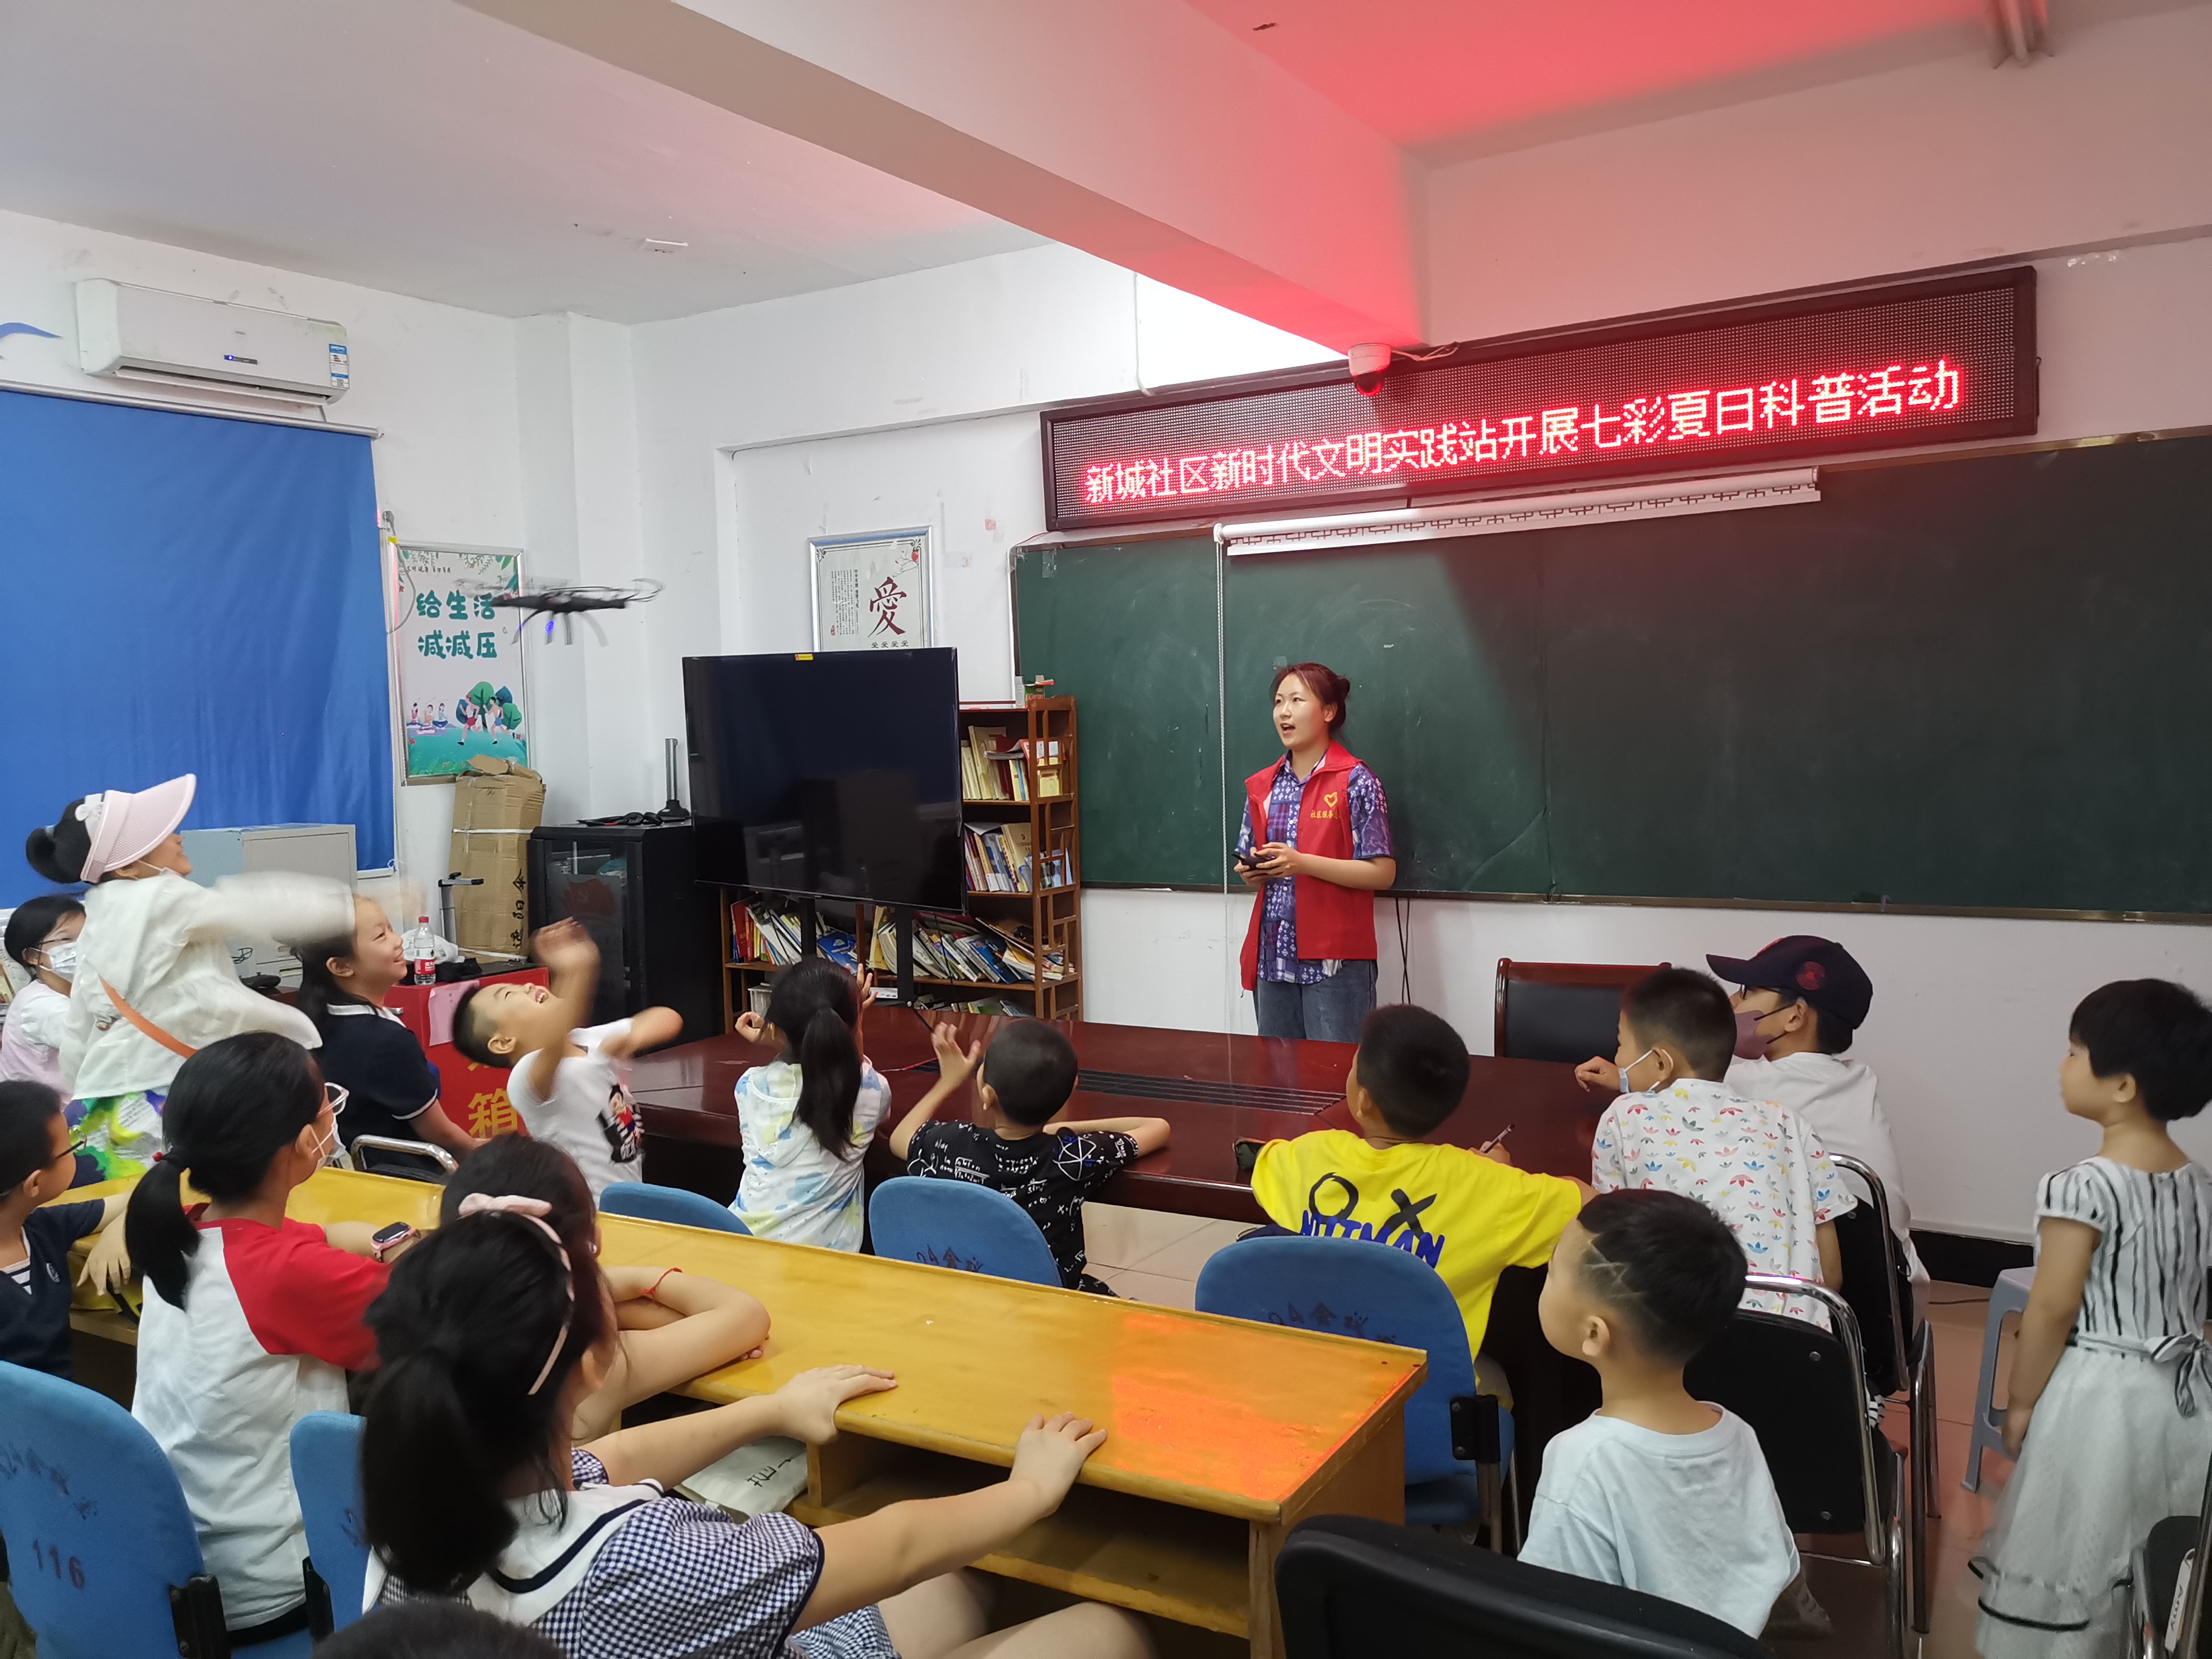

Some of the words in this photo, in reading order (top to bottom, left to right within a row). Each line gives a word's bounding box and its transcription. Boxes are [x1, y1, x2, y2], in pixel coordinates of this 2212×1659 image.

[1083, 357, 1962, 504] 新城社区新时代文明实践站开展七彩夏日科普活动
[416, 589, 496, 620] 给生活
[867, 575, 908, 638] 愛
[418, 629, 498, 659] 减减压
[468, 1088, 518, 1139] 箱
[32, 1538, 85, 1590] 116
